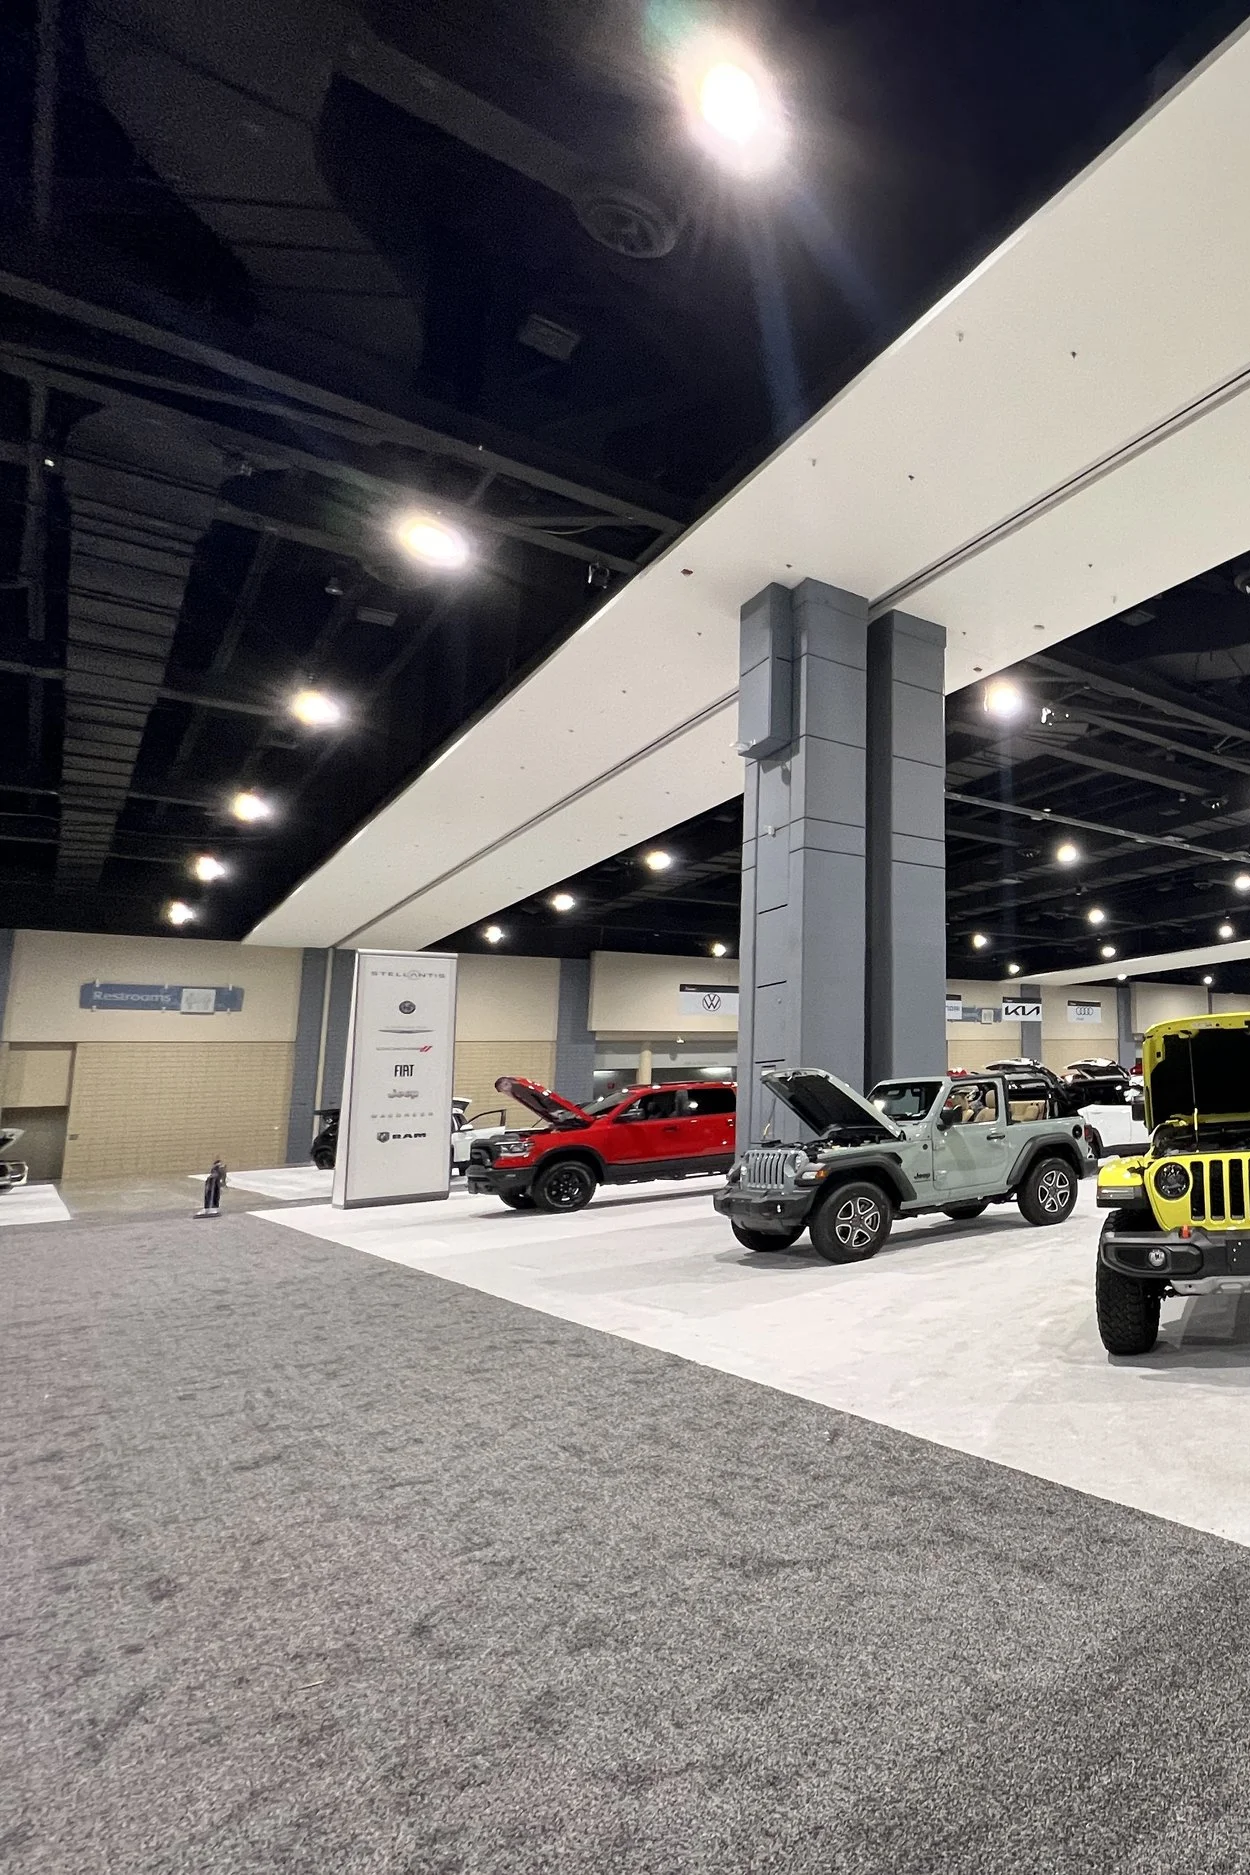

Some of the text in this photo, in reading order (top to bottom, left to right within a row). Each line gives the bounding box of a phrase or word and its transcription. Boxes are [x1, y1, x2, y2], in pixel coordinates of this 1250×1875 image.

[371, 971, 445, 979] STELLANTIS
[93, 991, 171, 1002] Restrooms
[1004, 1005, 1040, 1016] KIA
[394, 1064, 415, 1077] FIAT
[388, 1089, 419, 1099] Jeep
[914, 1172, 931, 1180] Jeep
